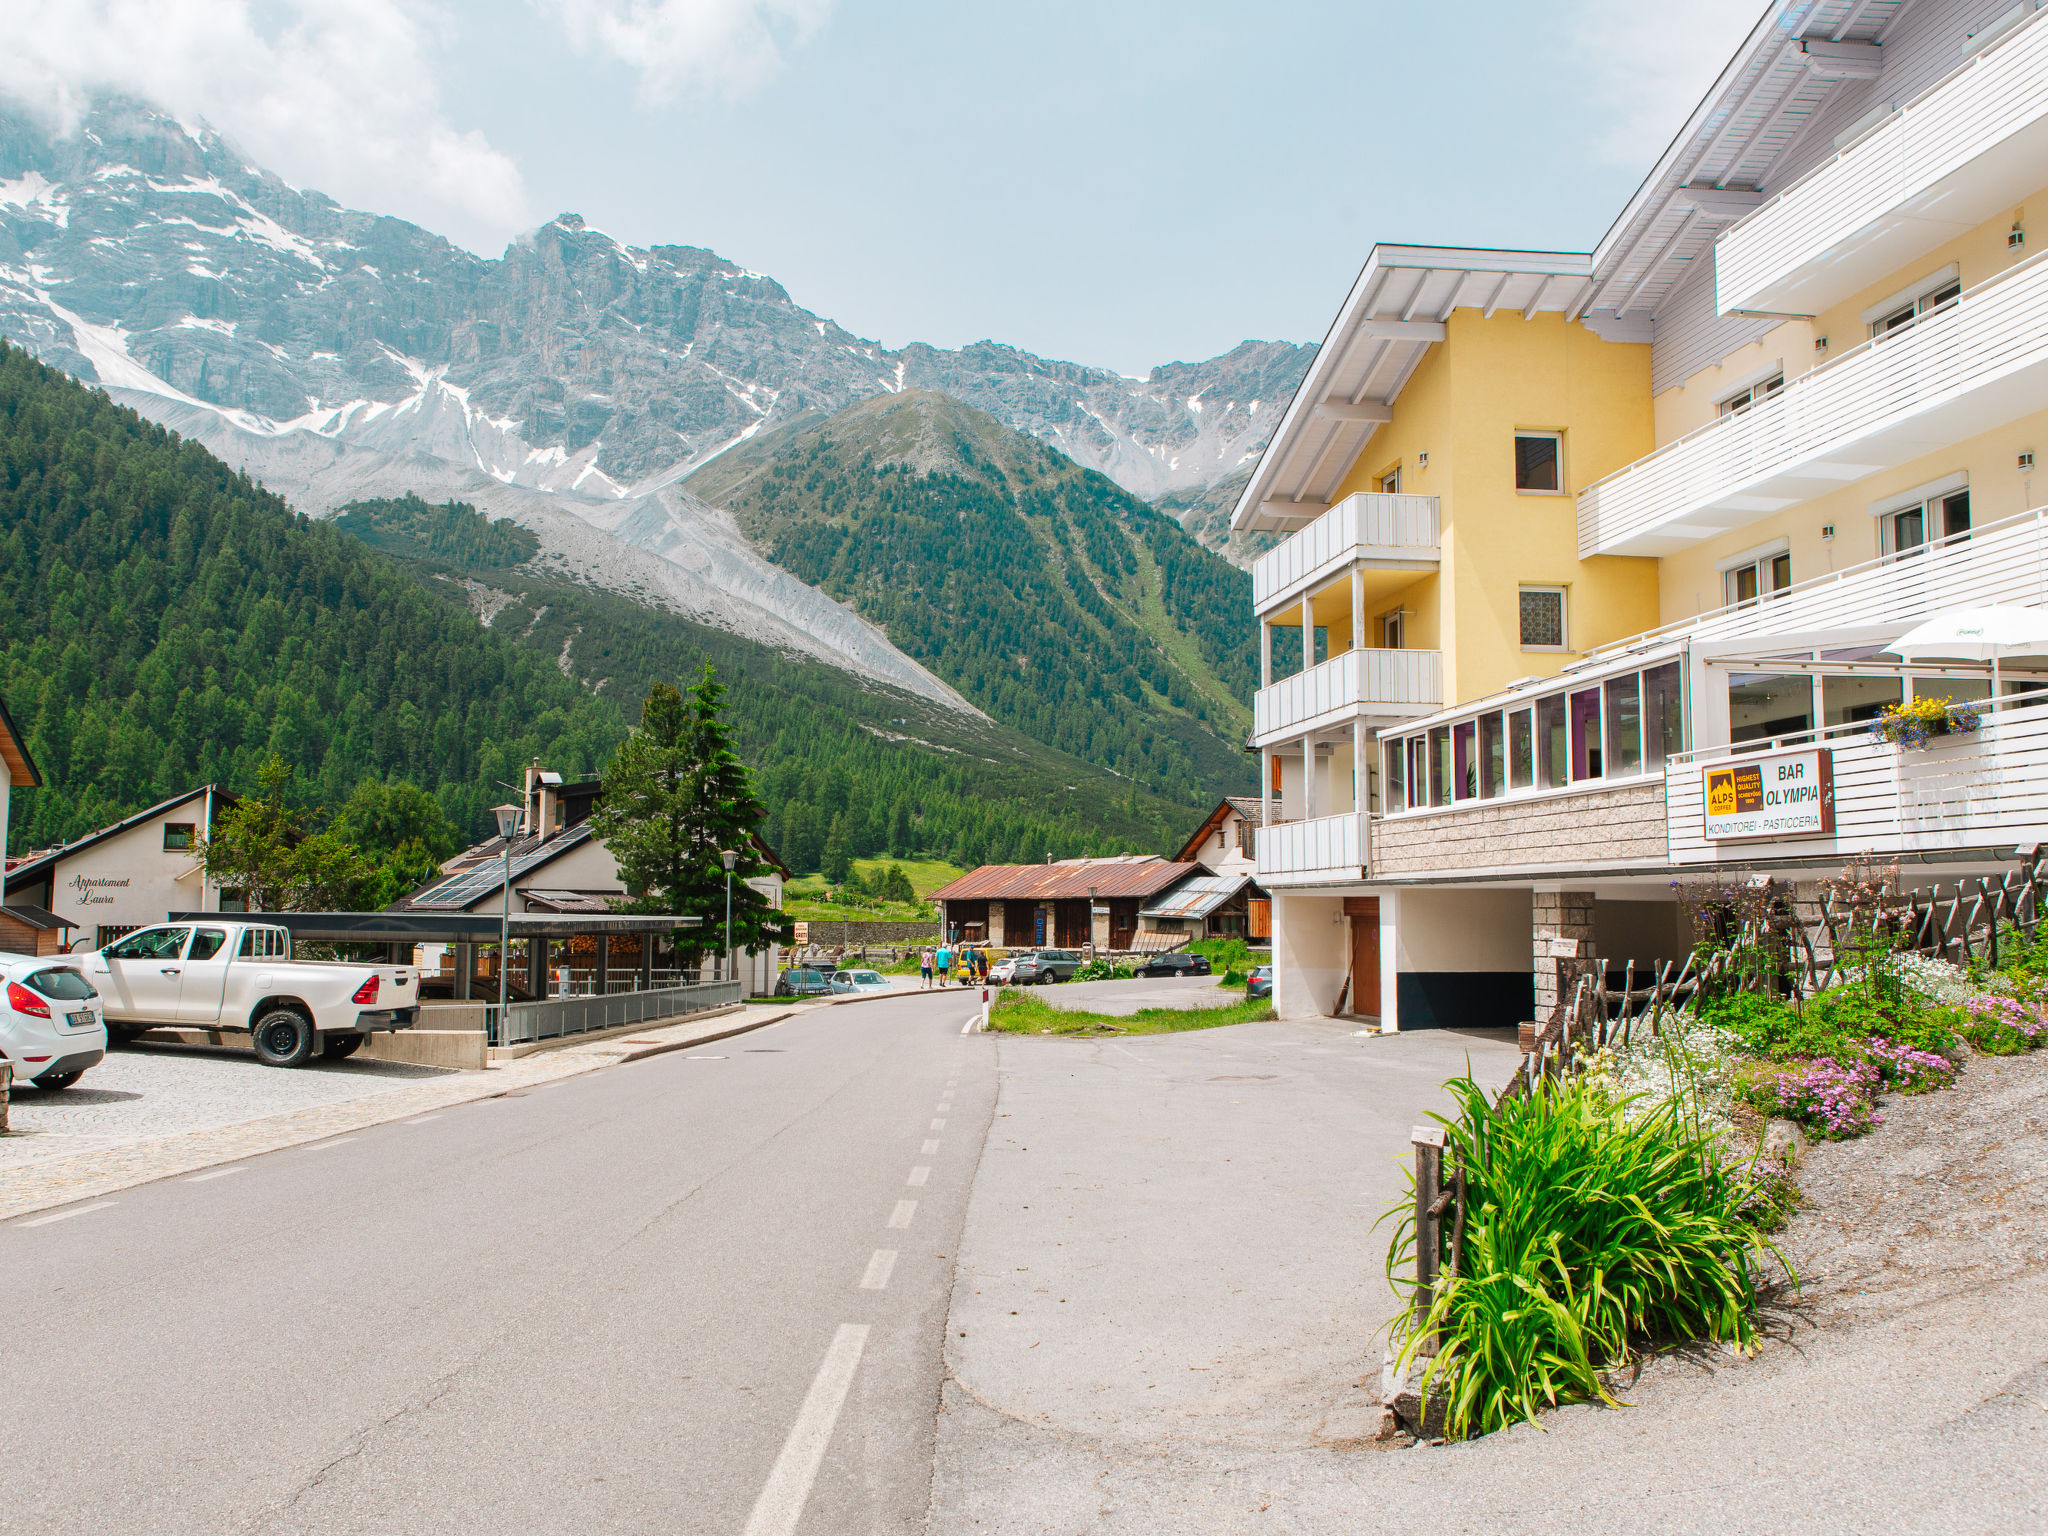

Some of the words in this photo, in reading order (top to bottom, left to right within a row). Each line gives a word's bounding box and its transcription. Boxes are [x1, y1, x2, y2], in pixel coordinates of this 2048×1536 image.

[1736, 774, 1760, 782] HIGHEST
[1778, 763, 1804, 781] BAR
[1737, 782, 1761, 791] QUALITY
[1712, 793, 1734, 805] ALPS
[1766, 785, 1818, 806] OLYMPIA
[1708, 821, 1757, 834] KONDITOREI
[1763, 815, 1819, 831] PASTICCERIA
[69, 874, 130, 891] Appartement
[76, 889, 114, 905] Laura
